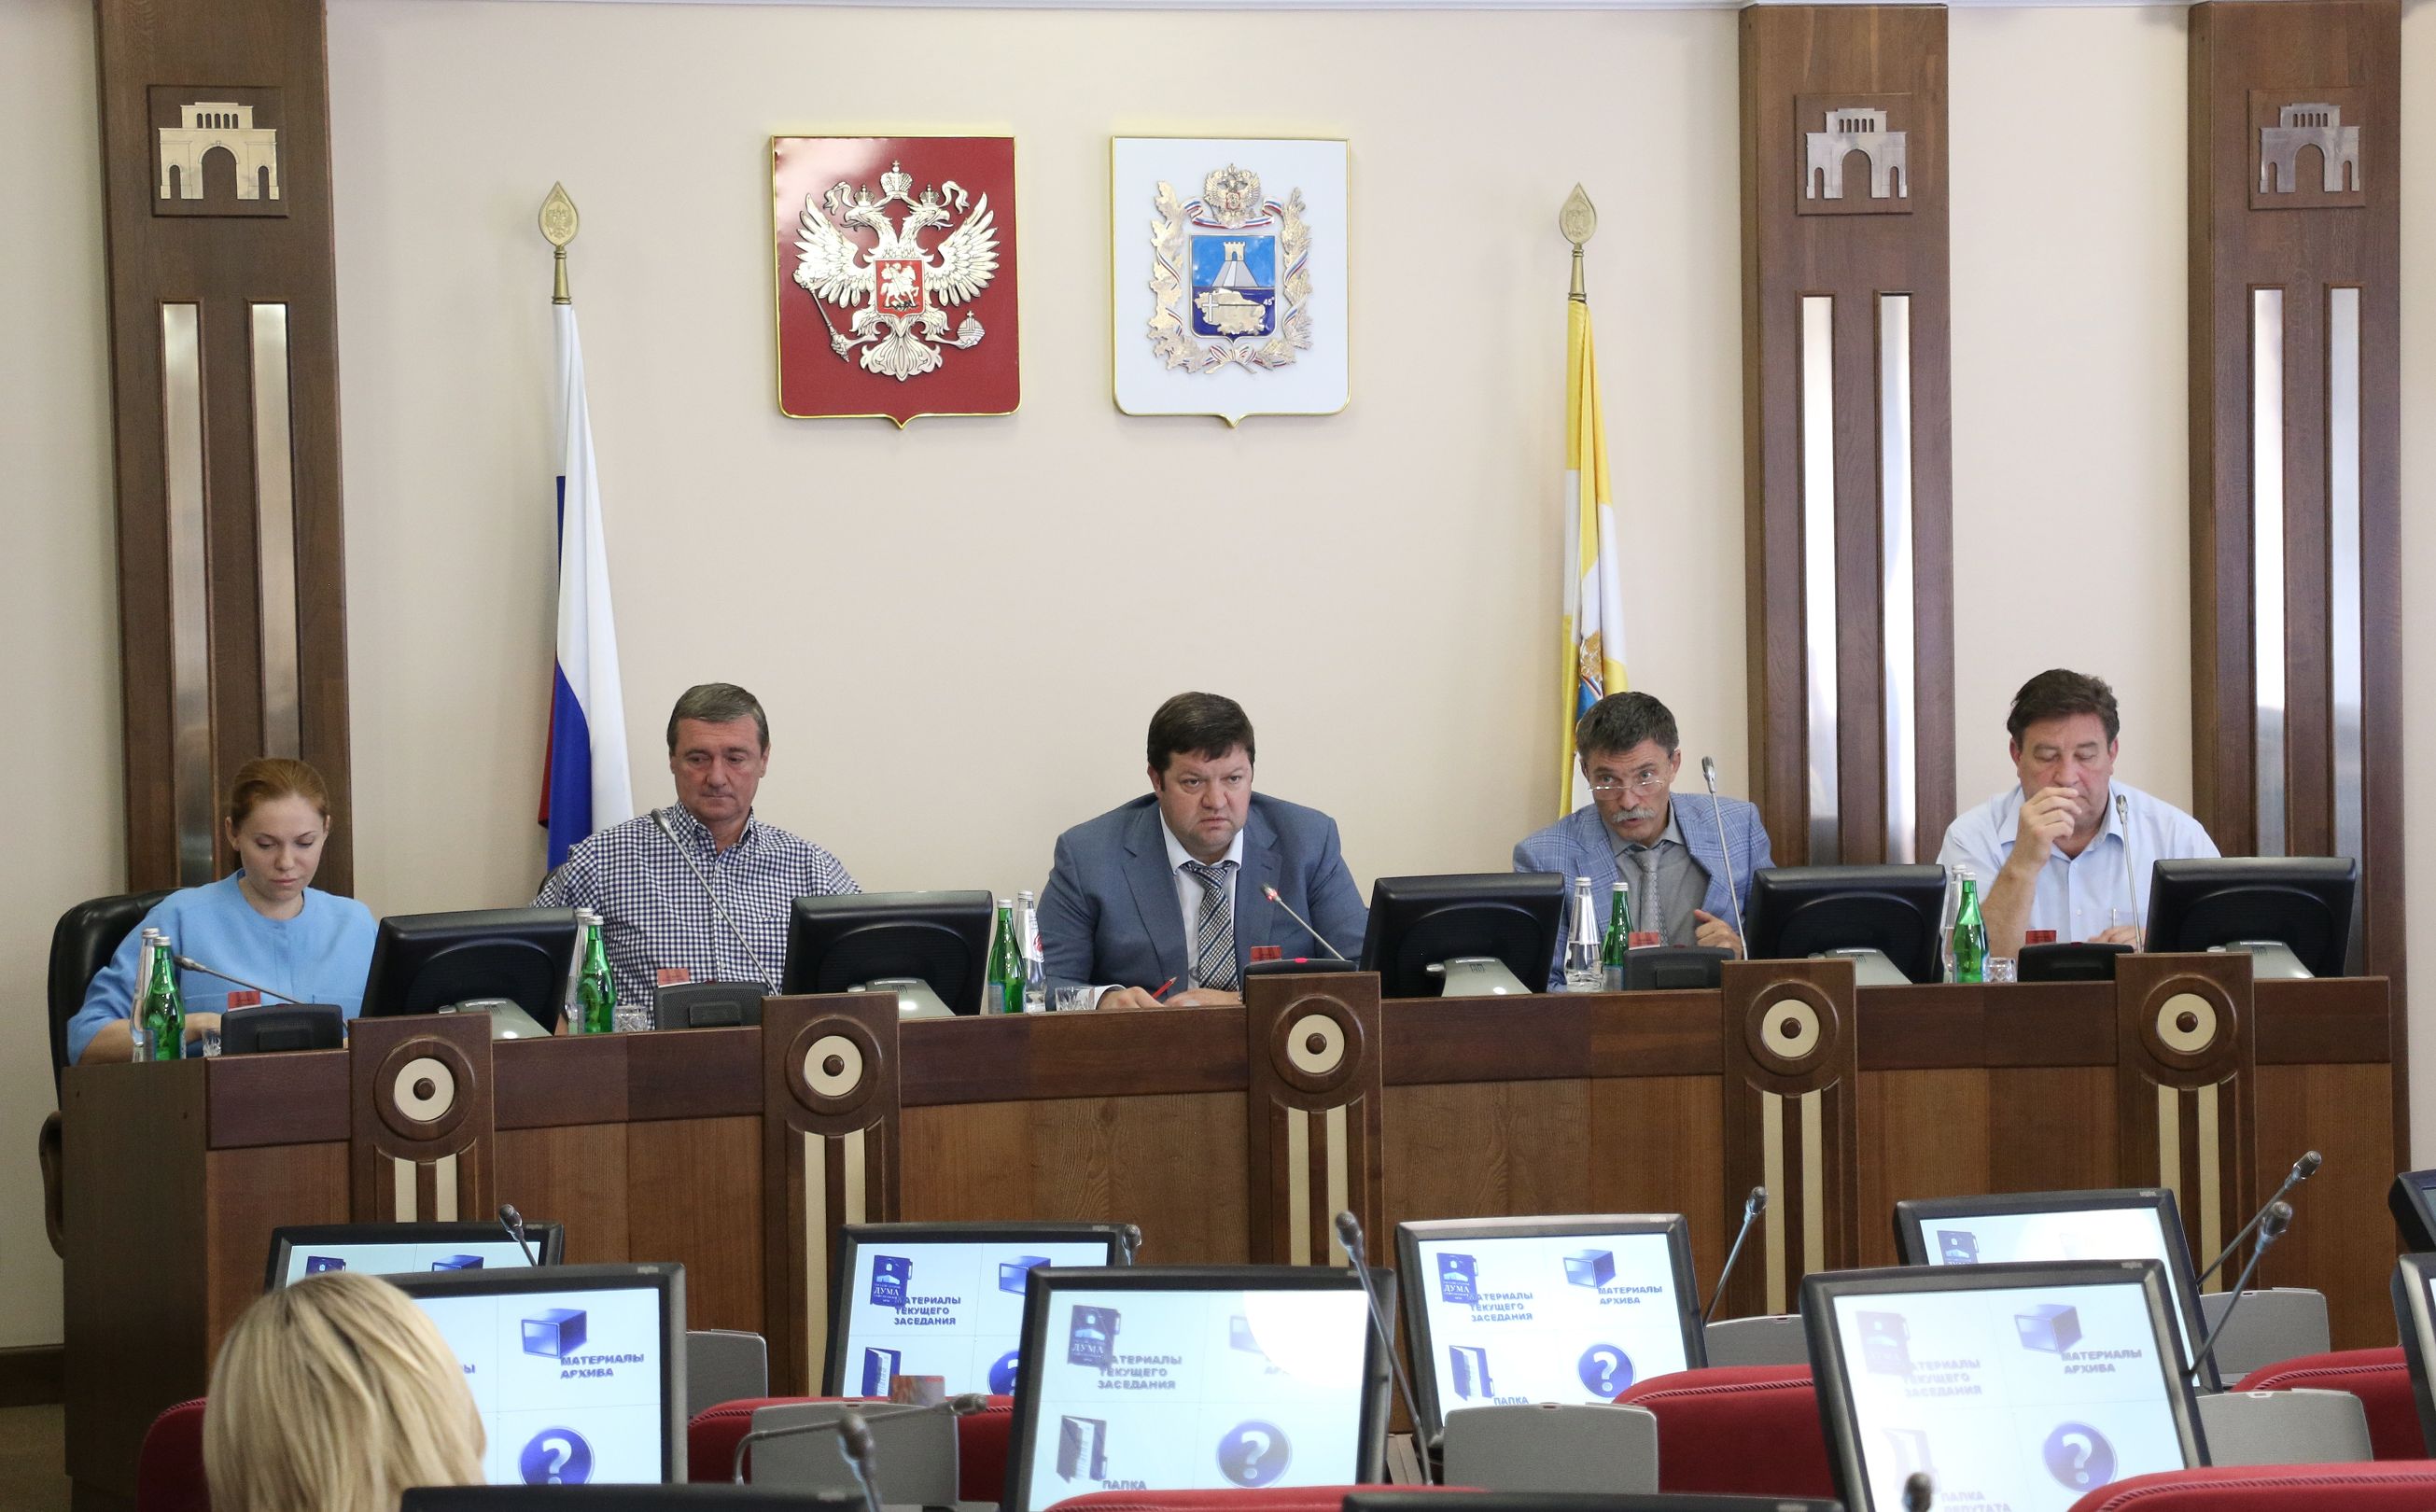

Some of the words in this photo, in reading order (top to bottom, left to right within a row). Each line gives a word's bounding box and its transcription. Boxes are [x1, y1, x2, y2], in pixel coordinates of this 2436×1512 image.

[874, 1287, 900, 1296] ДУМА
[1444, 1283, 1470, 1294] ДУМА
[1598, 1286, 1663, 1295] МАТЕРИАЛЫ
[895, 1296, 961, 1305] АТЕРИАЛЫ
[895, 1307, 950, 1316] ТЕКУЩЕГО
[1470, 1302, 1525, 1312] ТЕКУЩЕГО
[894, 1317, 956, 1325] ЗАСЕДАНИЯ
[1471, 1312, 1533, 1323] ЗАСЕДАНИЯ
[1072, 1342, 1104, 1354] ДУМА
[560, 1353, 644, 1366] МАТЕРИАЛЫ
[1102, 1354, 1183, 1365] АТЕРИАЛЫ
[2061, 1349, 2142, 1361] МАТЕРИАЛЫ
[560, 1368, 614, 1379] АРХИВА
[1099, 1367, 1168, 1379] ТЕКУЩЕГО
[2065, 1364, 2116, 1375] АРХИВА
[1098, 1379, 1176, 1390] ЗАСЕДАНИЯ
[1493, 1396, 1530, 1406] ПАПКА
[1102, 1480, 1147, 1491] ПАПКА
